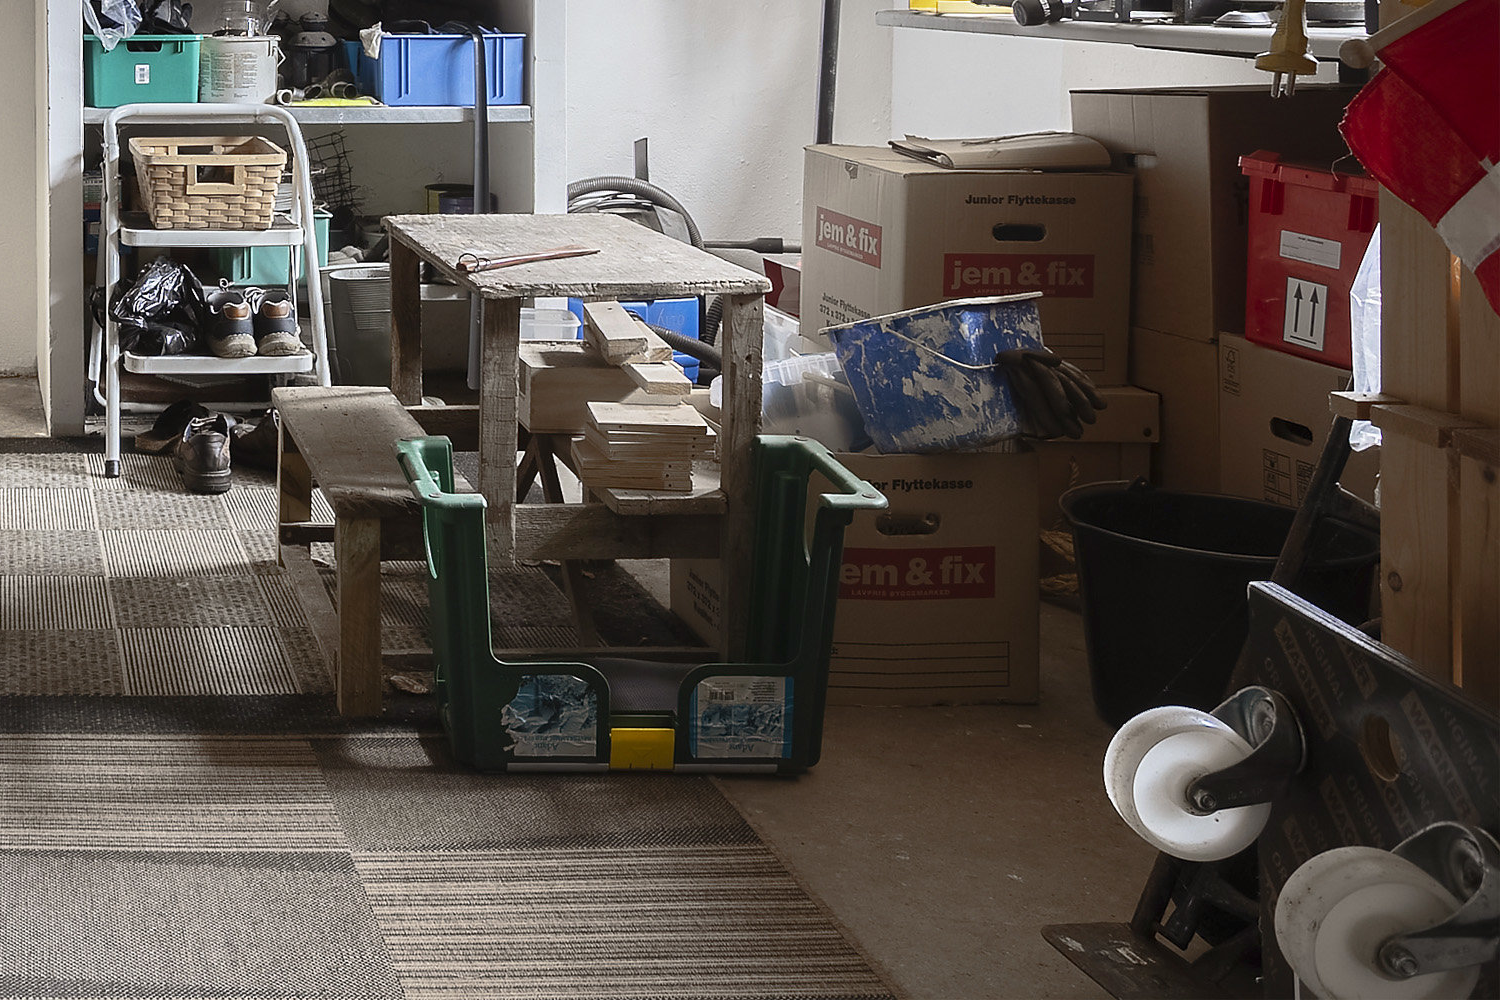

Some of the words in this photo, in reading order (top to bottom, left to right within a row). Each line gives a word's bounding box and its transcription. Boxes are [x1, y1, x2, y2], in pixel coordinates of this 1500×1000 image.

[965, 194, 1004, 205] Junior
[1008, 194, 1077, 207] Flyttekasse
[818, 213, 844, 244] jem
[846, 223, 858, 249] &
[858, 227, 879, 256] fix
[951, 260, 1012, 290] jem
[1017, 260, 1043, 287] &
[1046, 260, 1086, 287] fix
[892, 478, 973, 493] Flyttekasse
[839, 561, 899, 586] em
[905, 557, 935, 587] &
[940, 555, 987, 586] fix
